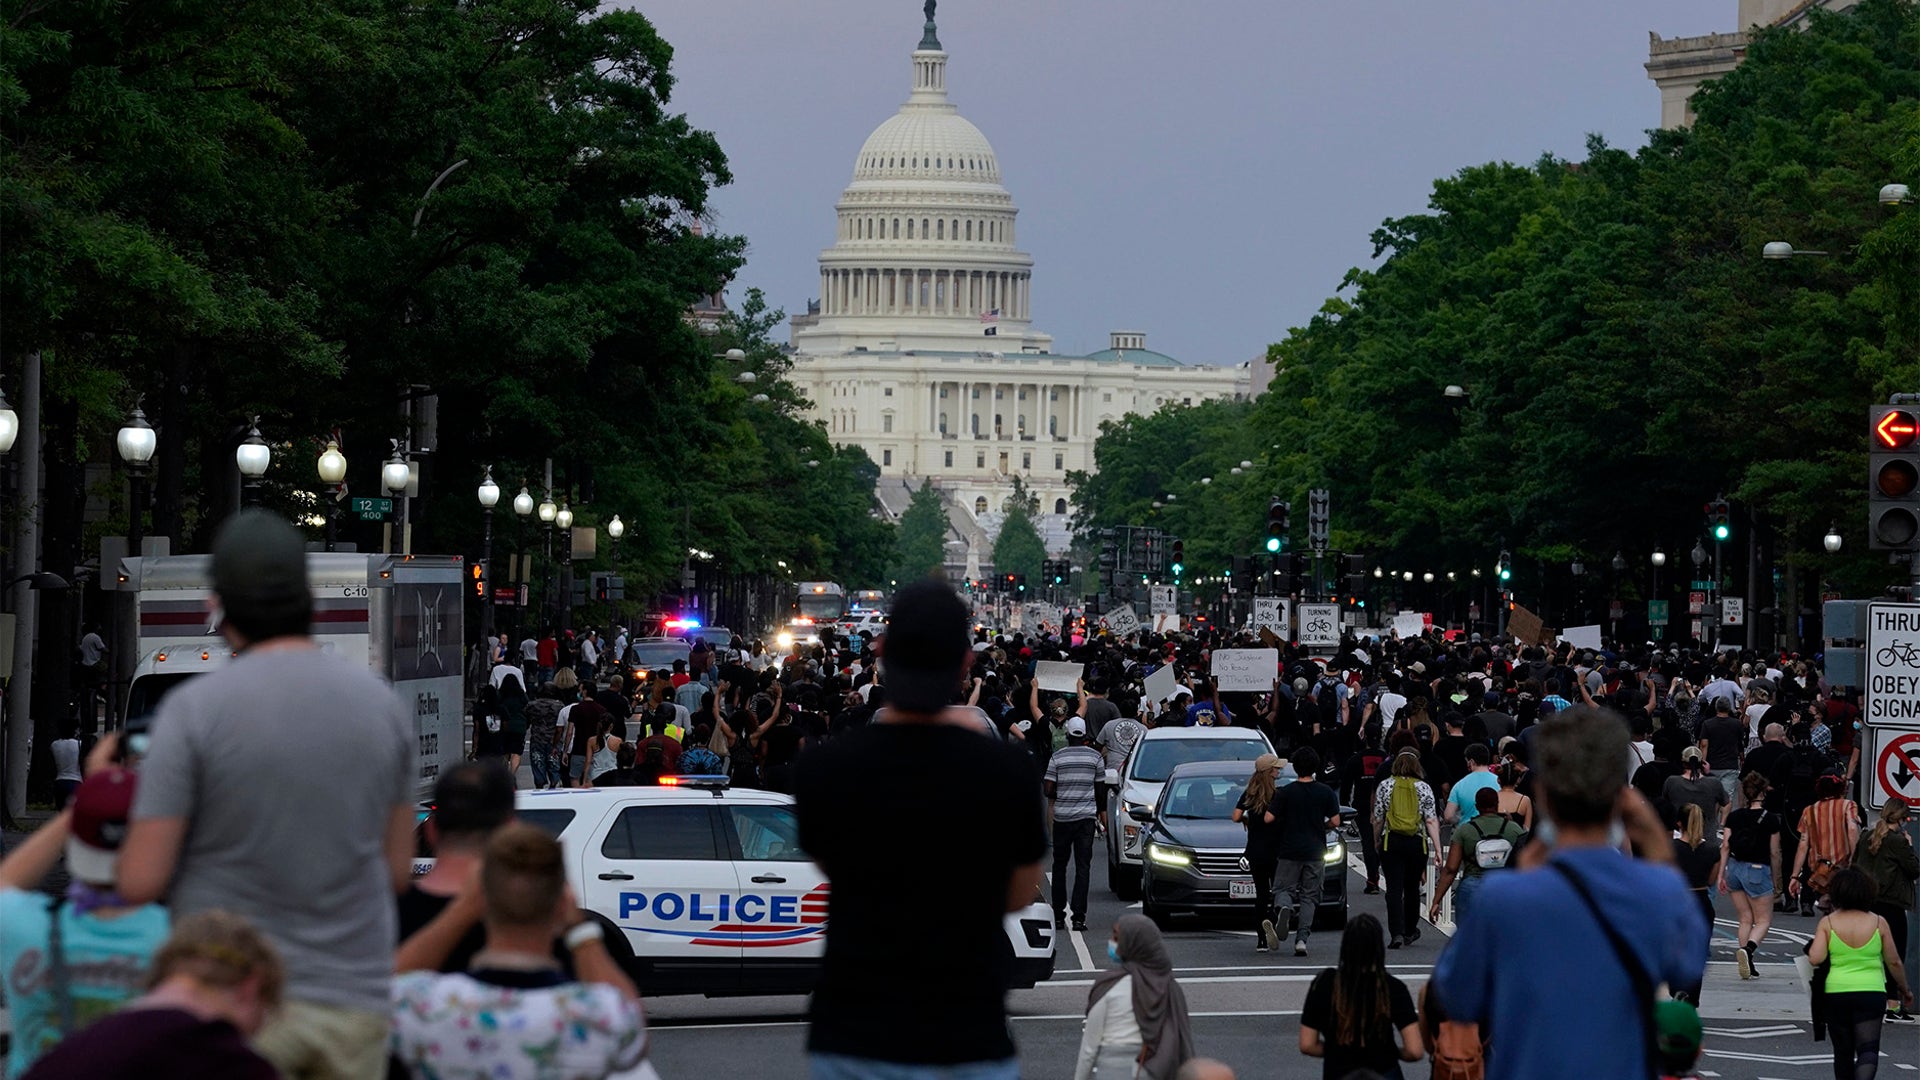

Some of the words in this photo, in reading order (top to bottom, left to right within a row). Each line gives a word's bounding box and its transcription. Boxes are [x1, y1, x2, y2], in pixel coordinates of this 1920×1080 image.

[359, 500, 373, 511] 12
[362, 512, 381, 520] 400
[344, 588, 368, 597] C-10
[1257, 600, 1273, 609] THRU
[1875, 612, 1920, 632] THRU
[1275, 623, 1288, 632] THIS
[1218, 652, 1230, 661] No
[1218, 663, 1229, 671] No
[1872, 675, 1919, 695] OBEY
[619, 892, 798, 924] POLICE
